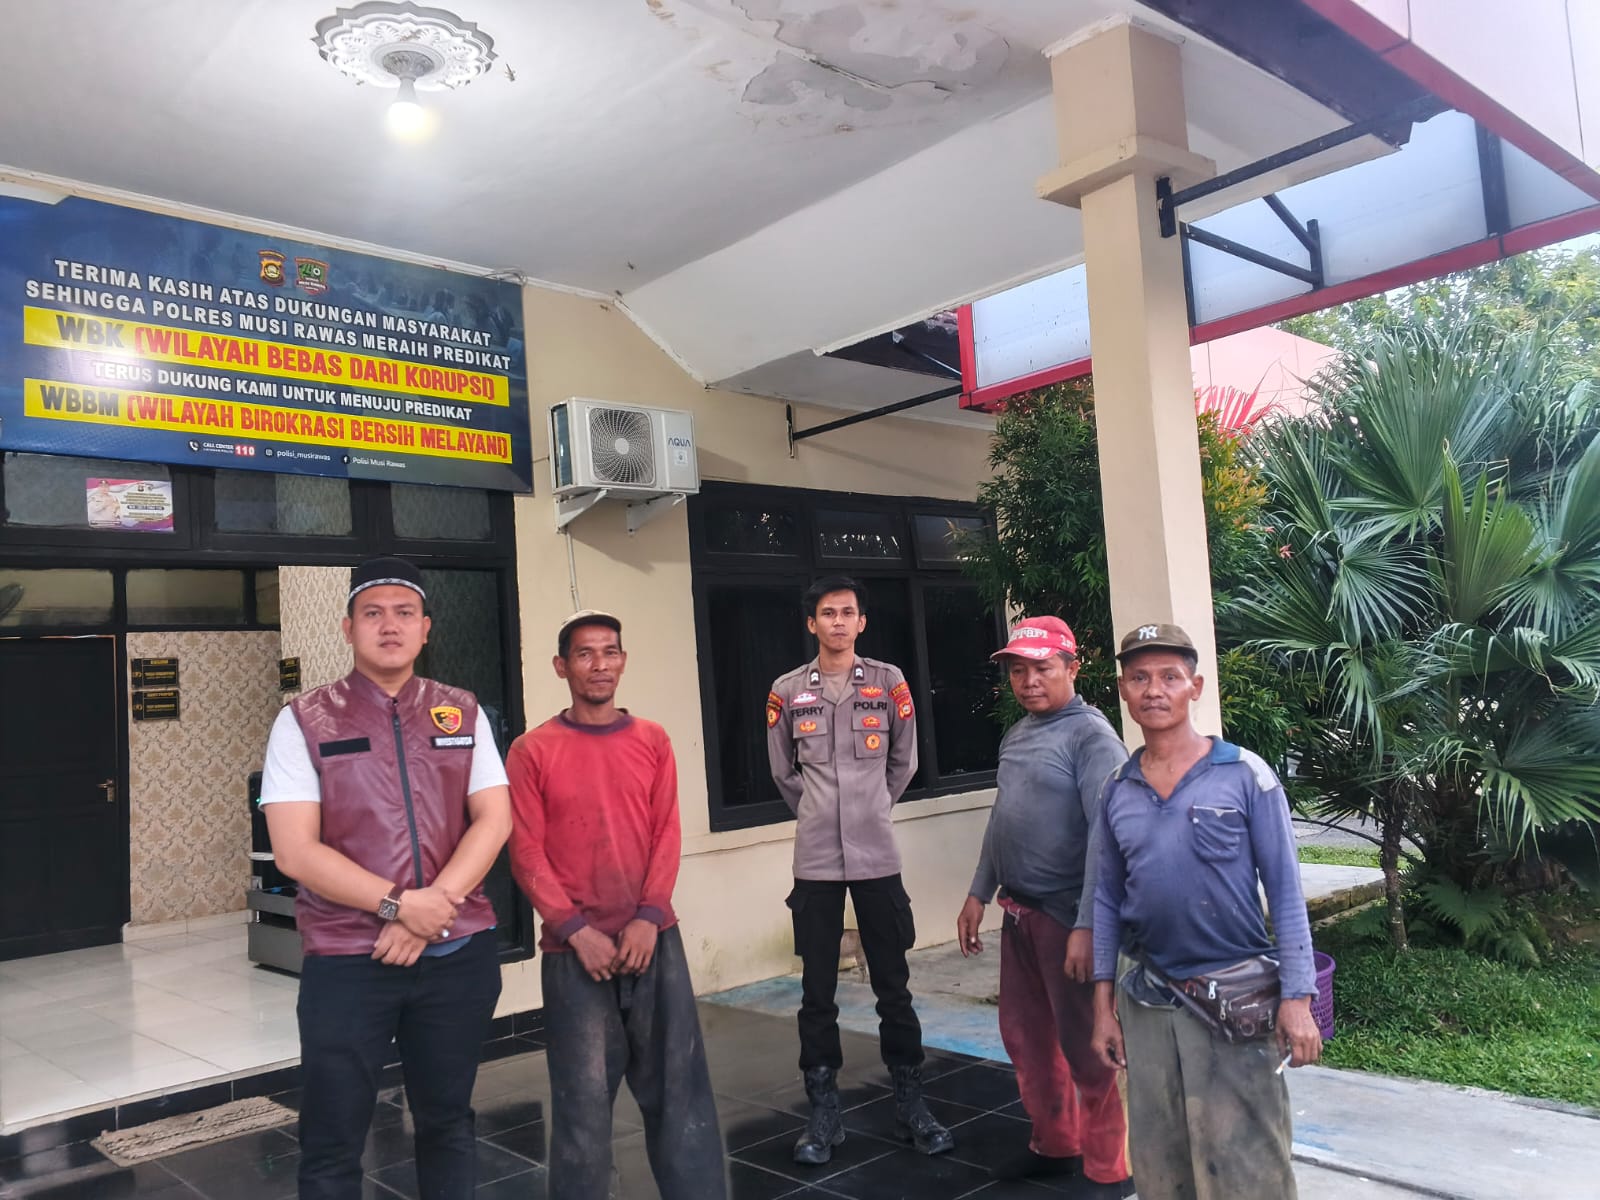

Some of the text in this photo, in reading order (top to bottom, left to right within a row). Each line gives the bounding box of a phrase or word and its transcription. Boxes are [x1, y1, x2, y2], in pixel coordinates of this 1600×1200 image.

[54, 259, 491, 347] TERIMA KASIH ATAS DUKUNGAN MASYARAKAT
[26, 280, 511, 370] SEHINGGA POLRES MUSI RAWAS MERAIH PREDIKAT
[55, 314, 495, 401] WBK (WILAYAH BEBAS DARI KORUPSI)
[91, 360, 472, 421] TERUS DUKUNG KAMI UNTUK MENUJU PREDIKAT
[40, 384, 508, 459] WBBM (WILAYAH BIROKRASI BERSIH MELAYANI)
[668, 437, 691, 447] AQUA
[235, 445, 255, 456] 110
[276, 449, 331, 461] polisi_musirawas
[352, 456, 406, 469] Polisi Musi Rawas
[790, 705, 825, 718] FERRY
[854, 701, 888, 711] POLRI
